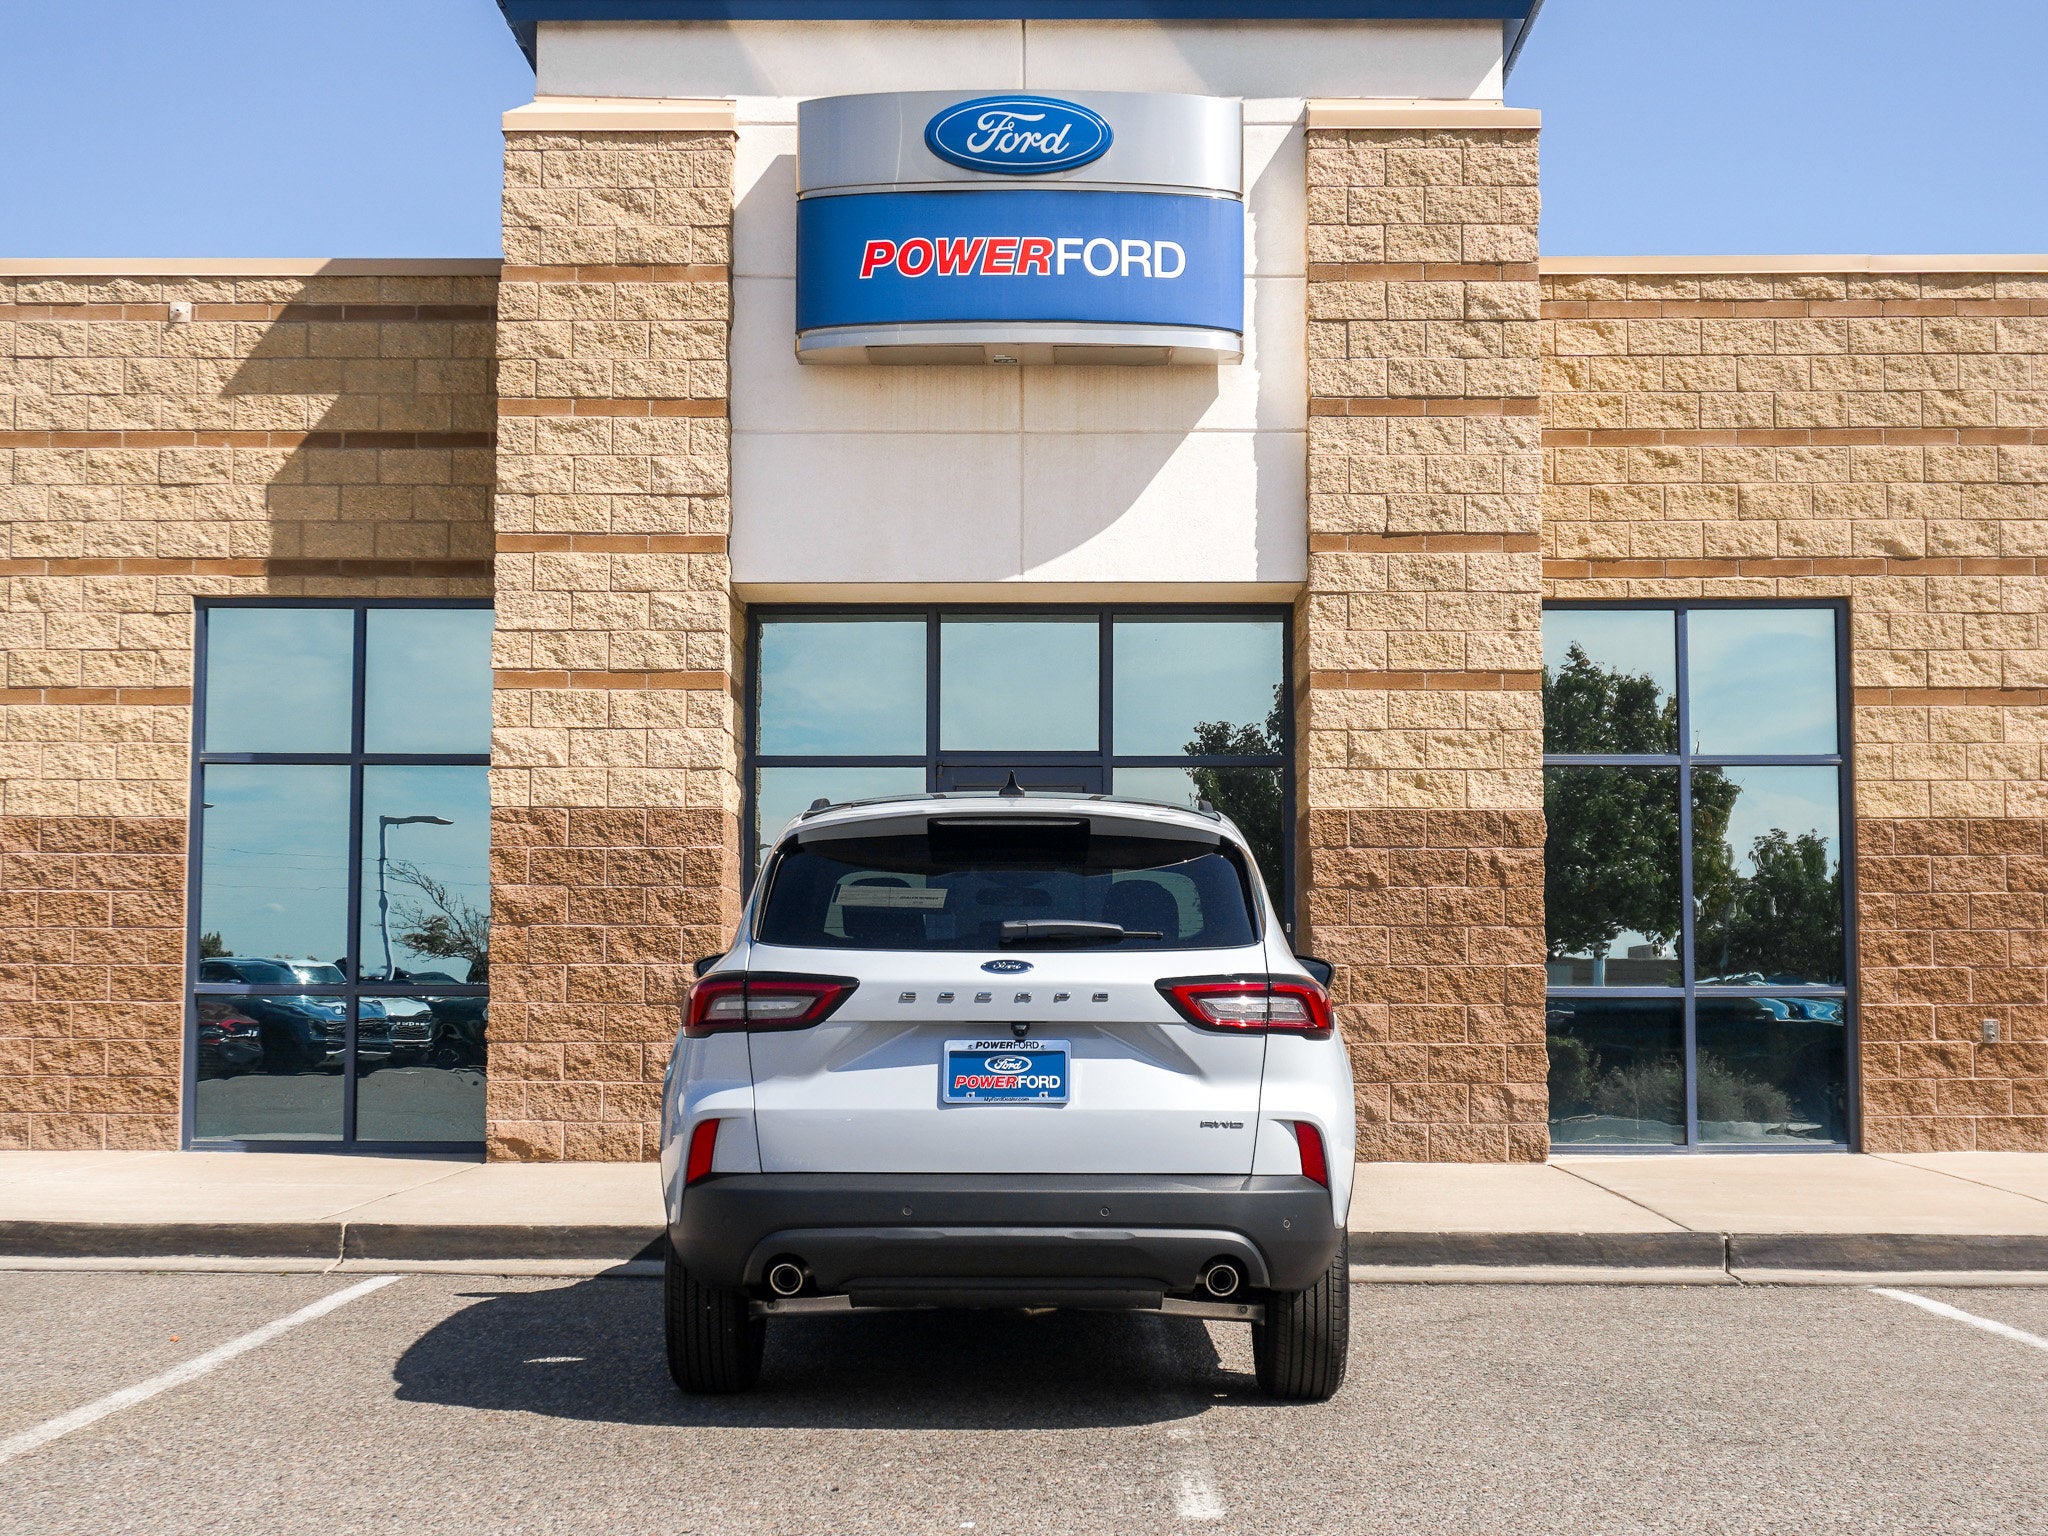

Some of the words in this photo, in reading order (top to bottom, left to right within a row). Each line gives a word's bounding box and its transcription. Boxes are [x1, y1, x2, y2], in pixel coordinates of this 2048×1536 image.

[966, 111, 1072, 154] Ford
[859, 236, 1186, 279] POWERFORD
[993, 960, 1022, 971] Ford
[898, 991, 1109, 1004] ESCAPE
[975, 1041, 1039, 1049] POWERFORD
[994, 1058, 1022, 1070] Ford
[954, 1075, 1061, 1089] POWERFORD
